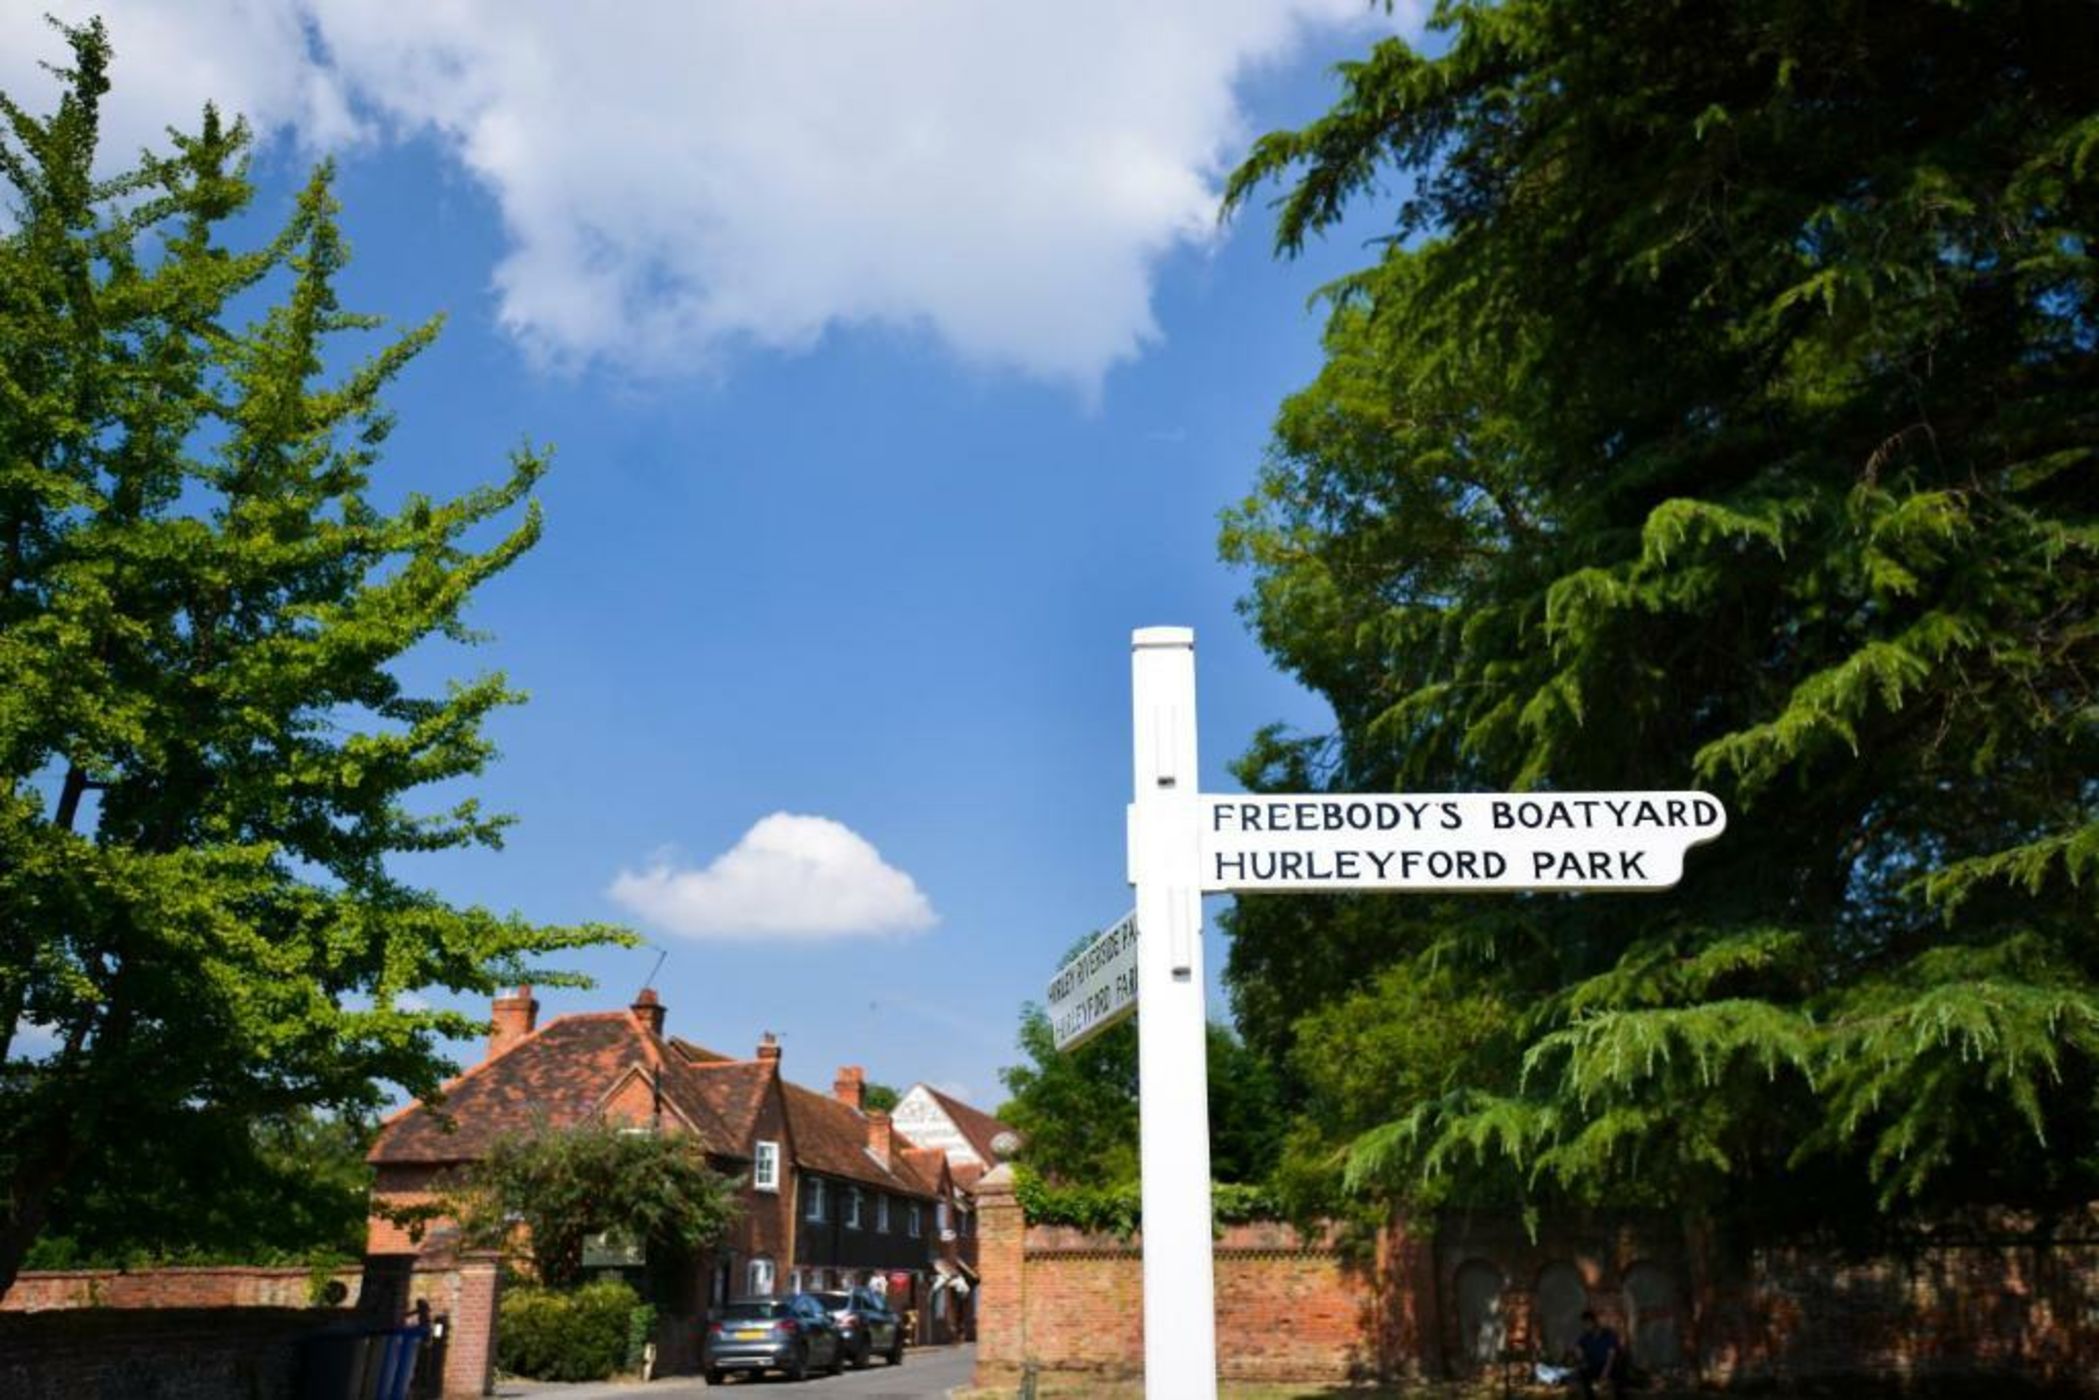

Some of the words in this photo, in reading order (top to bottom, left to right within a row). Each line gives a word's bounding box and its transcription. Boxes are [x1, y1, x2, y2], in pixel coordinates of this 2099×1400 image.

[1213, 802, 1463, 832] FREEBODY'S
[1493, 799, 1719, 830] BOATYARD
[1215, 850, 1507, 880] HURLEYFORD
[1533, 851, 1647, 880] PARK
